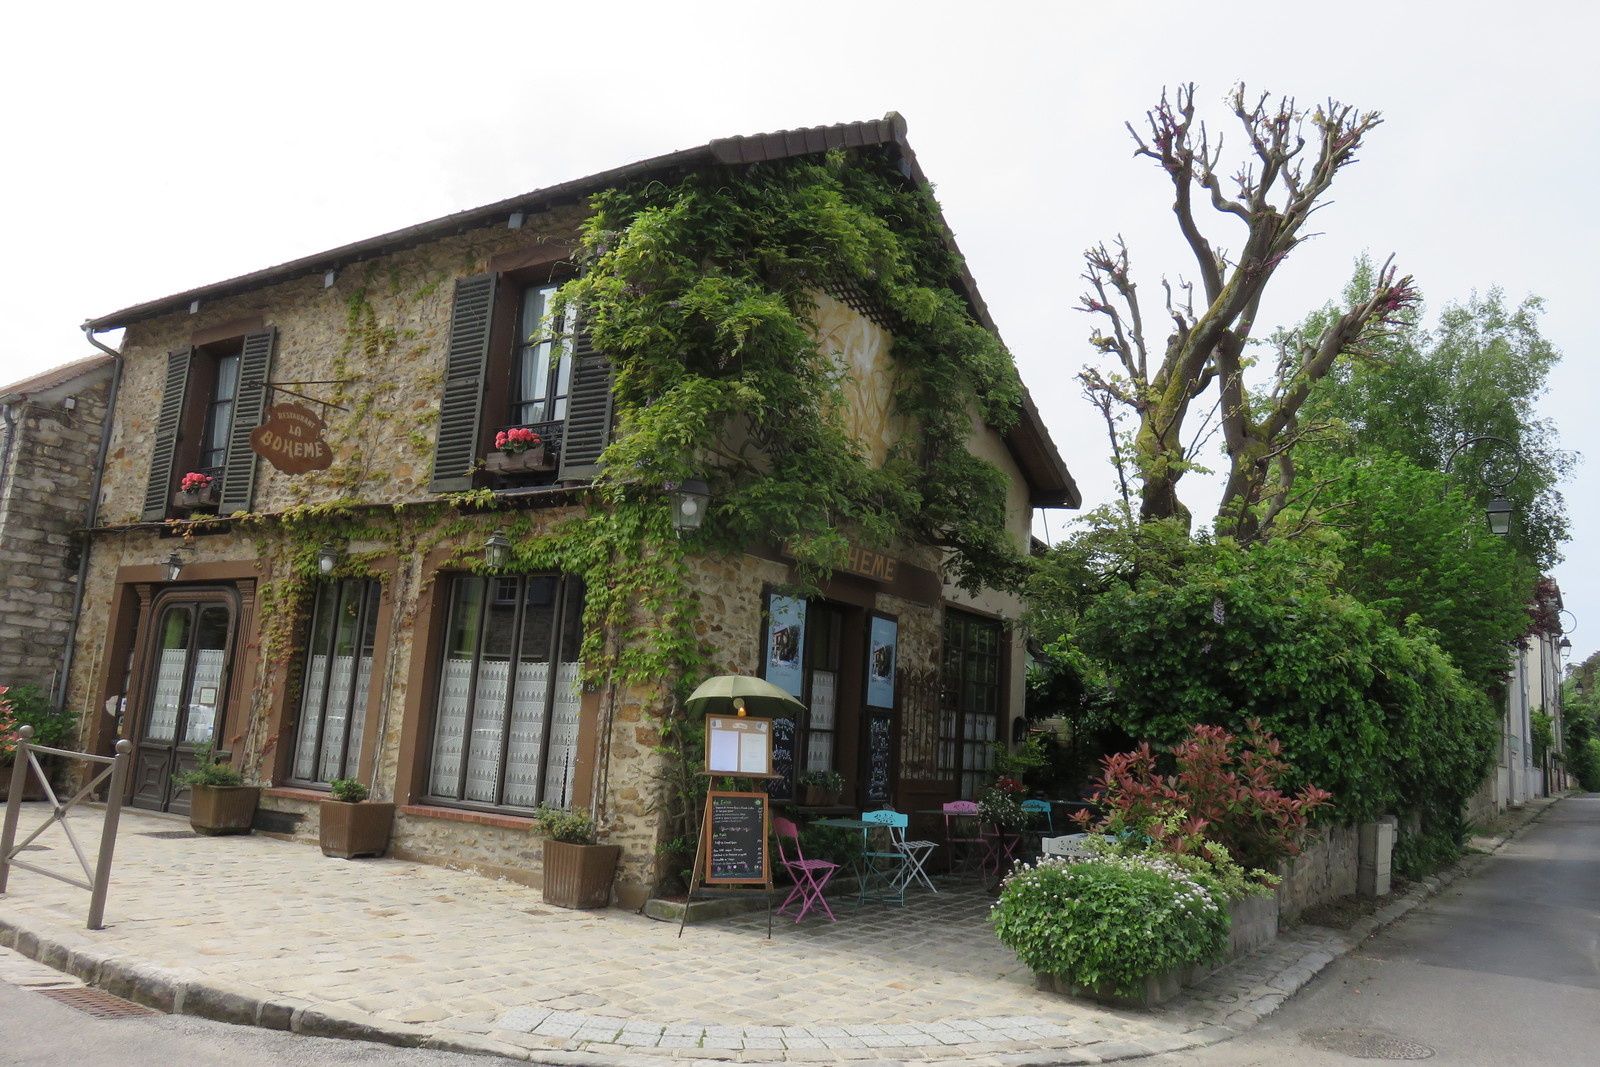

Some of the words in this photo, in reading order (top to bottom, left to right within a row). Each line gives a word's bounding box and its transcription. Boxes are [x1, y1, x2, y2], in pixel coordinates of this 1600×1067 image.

[261, 430, 323, 459] BOHEME
[288, 424, 302, 437] LA
[842, 546, 897, 581] HEME
